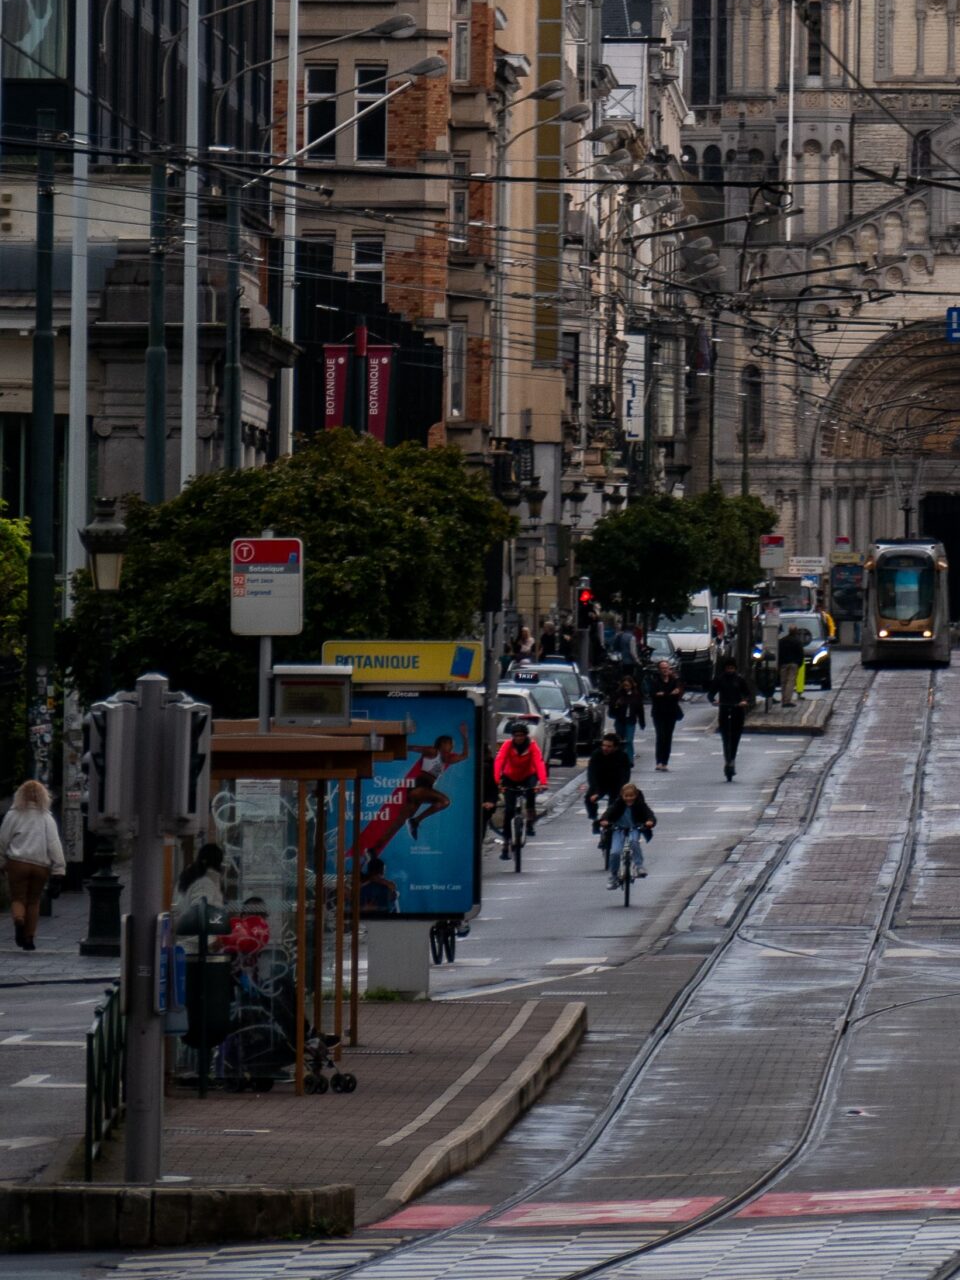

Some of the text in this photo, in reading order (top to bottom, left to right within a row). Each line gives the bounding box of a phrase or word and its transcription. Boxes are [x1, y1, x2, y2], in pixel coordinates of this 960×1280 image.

[325, 358, 336, 415] BOTANIQUE
[369, 358, 379, 415] BOTANIQUE
[240, 547, 250, 558] T
[248, 565, 285, 573] Botanique
[335, 655, 420, 669] BOTANIQUE
[373, 775, 416, 788] Steun
[366, 791, 403, 807] goud
